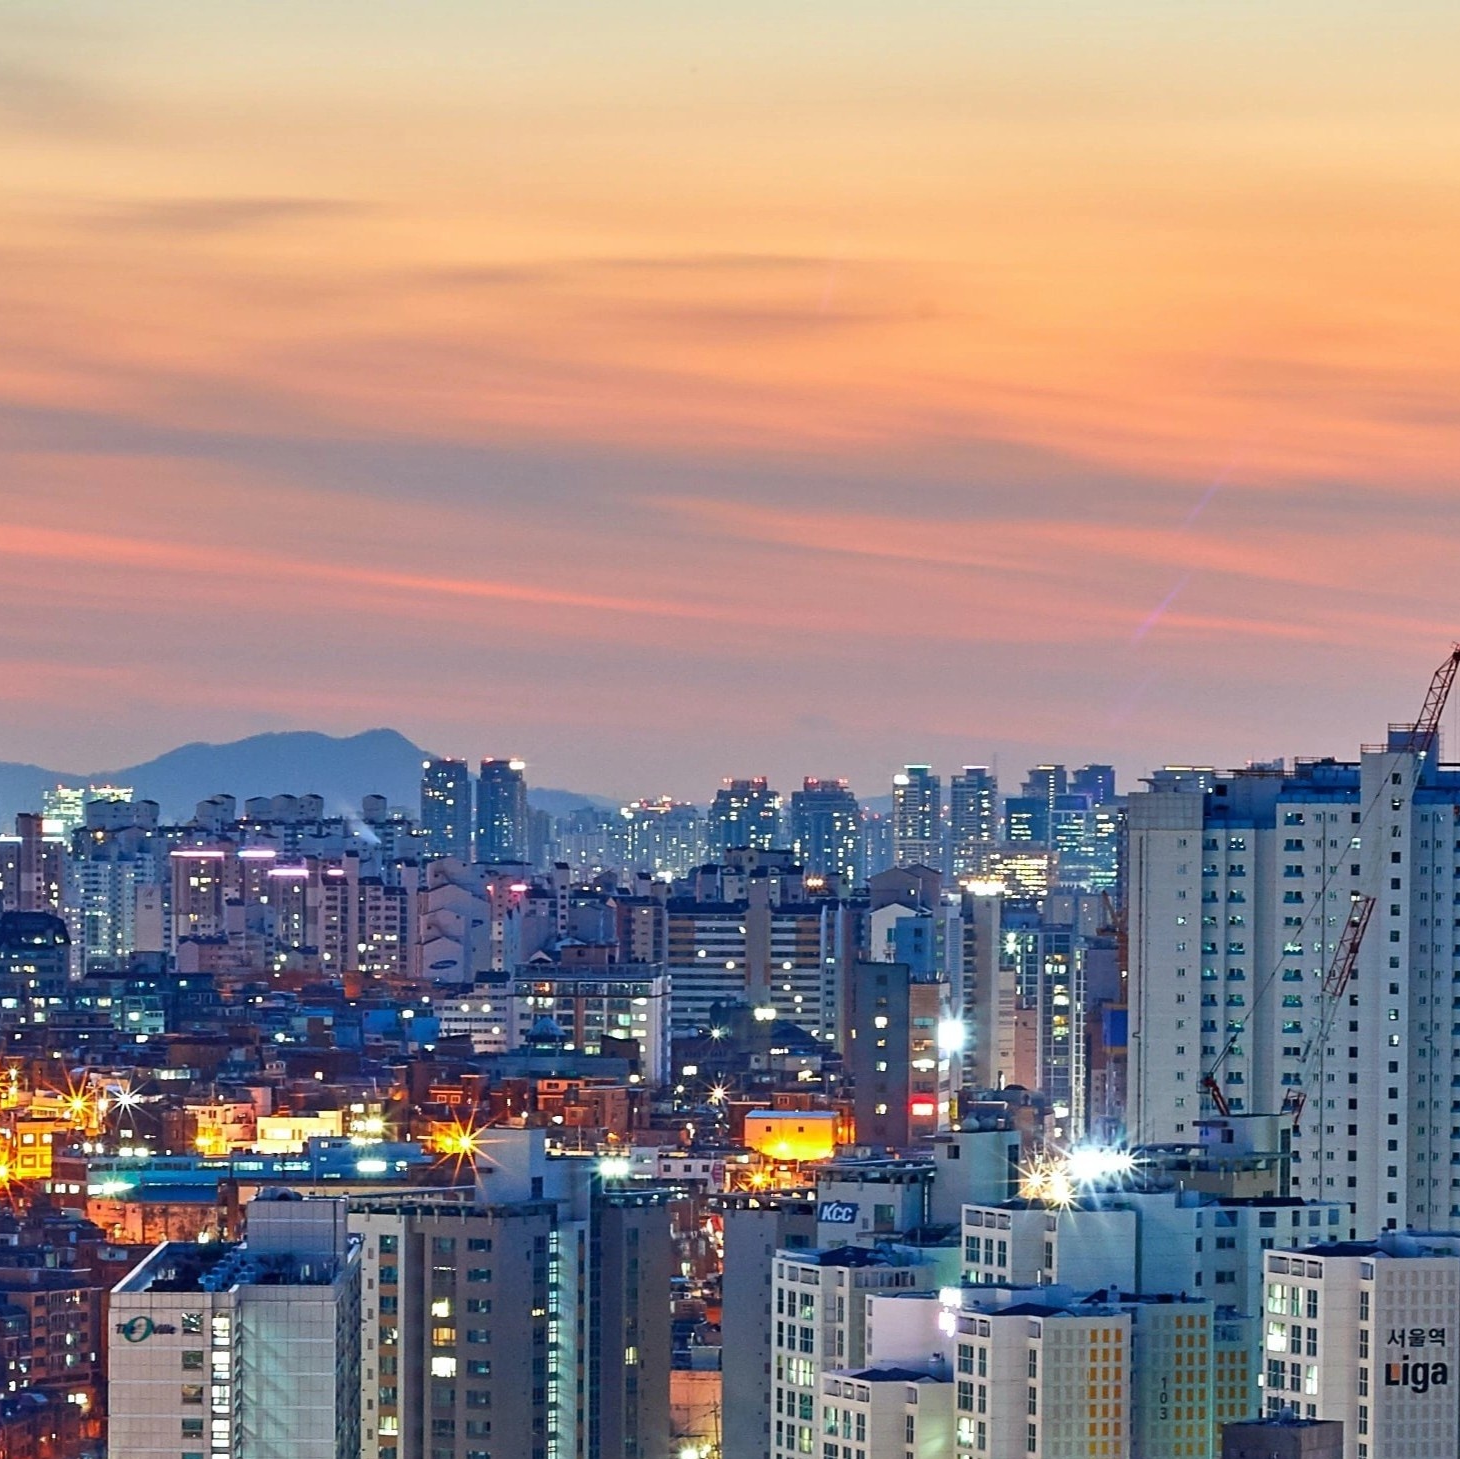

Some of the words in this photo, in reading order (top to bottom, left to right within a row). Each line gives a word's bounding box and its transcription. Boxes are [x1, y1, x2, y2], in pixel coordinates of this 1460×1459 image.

[822, 1203, 853, 1221] KCC
[1387, 1328, 1445, 1348] 서울역
[1385, 1354, 1448, 1394] Liga
[1160, 1376, 1168, 1420] 103
